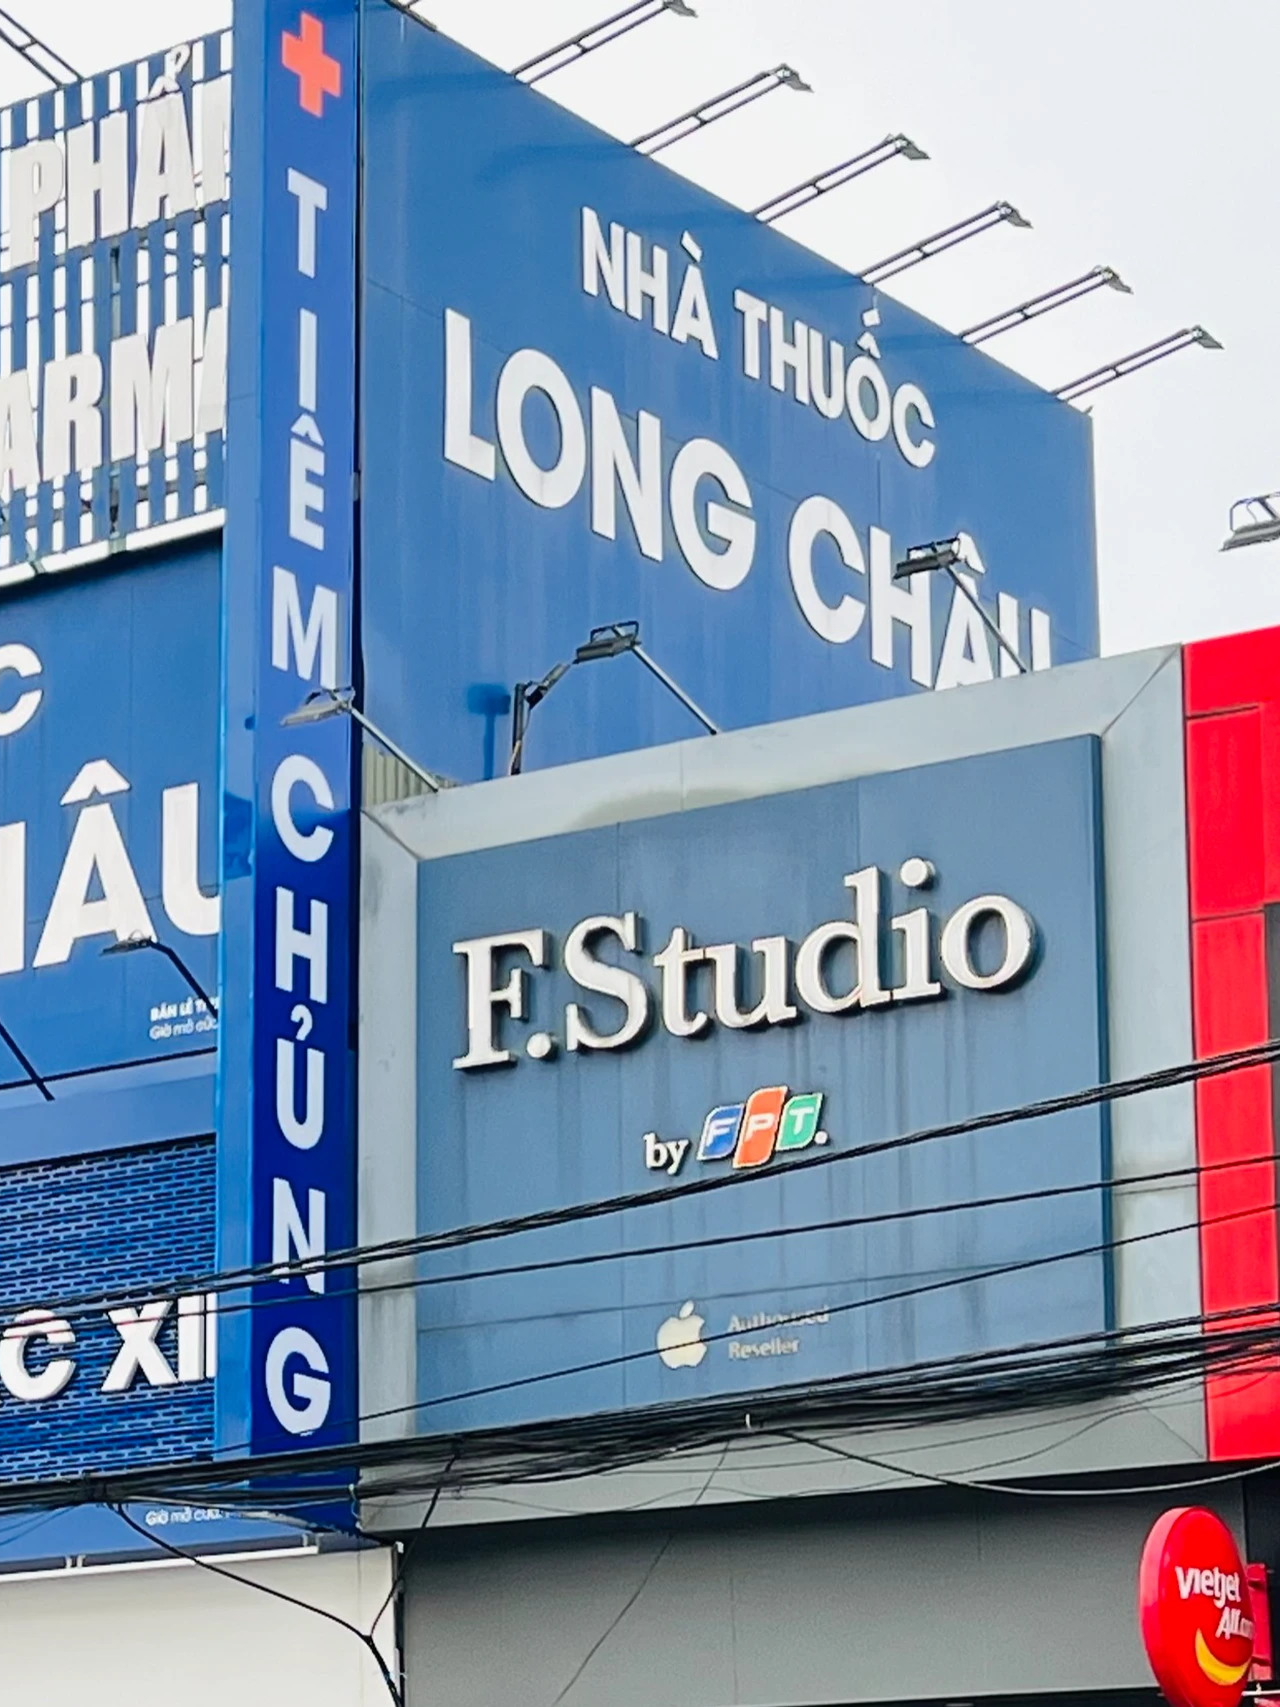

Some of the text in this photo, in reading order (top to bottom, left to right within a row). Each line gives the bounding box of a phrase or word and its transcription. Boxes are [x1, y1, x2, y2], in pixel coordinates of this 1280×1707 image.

[444, 307, 756, 590] LONG
[580, 206, 936, 468] NHÀ THUỐC
[265, 167, 337, 1437] TIÊM CHỦNG
[452, 858, 1035, 1071] F.Studio
[643, 1132, 689, 1175] by
[728, 1337, 800, 1359] Reseller
